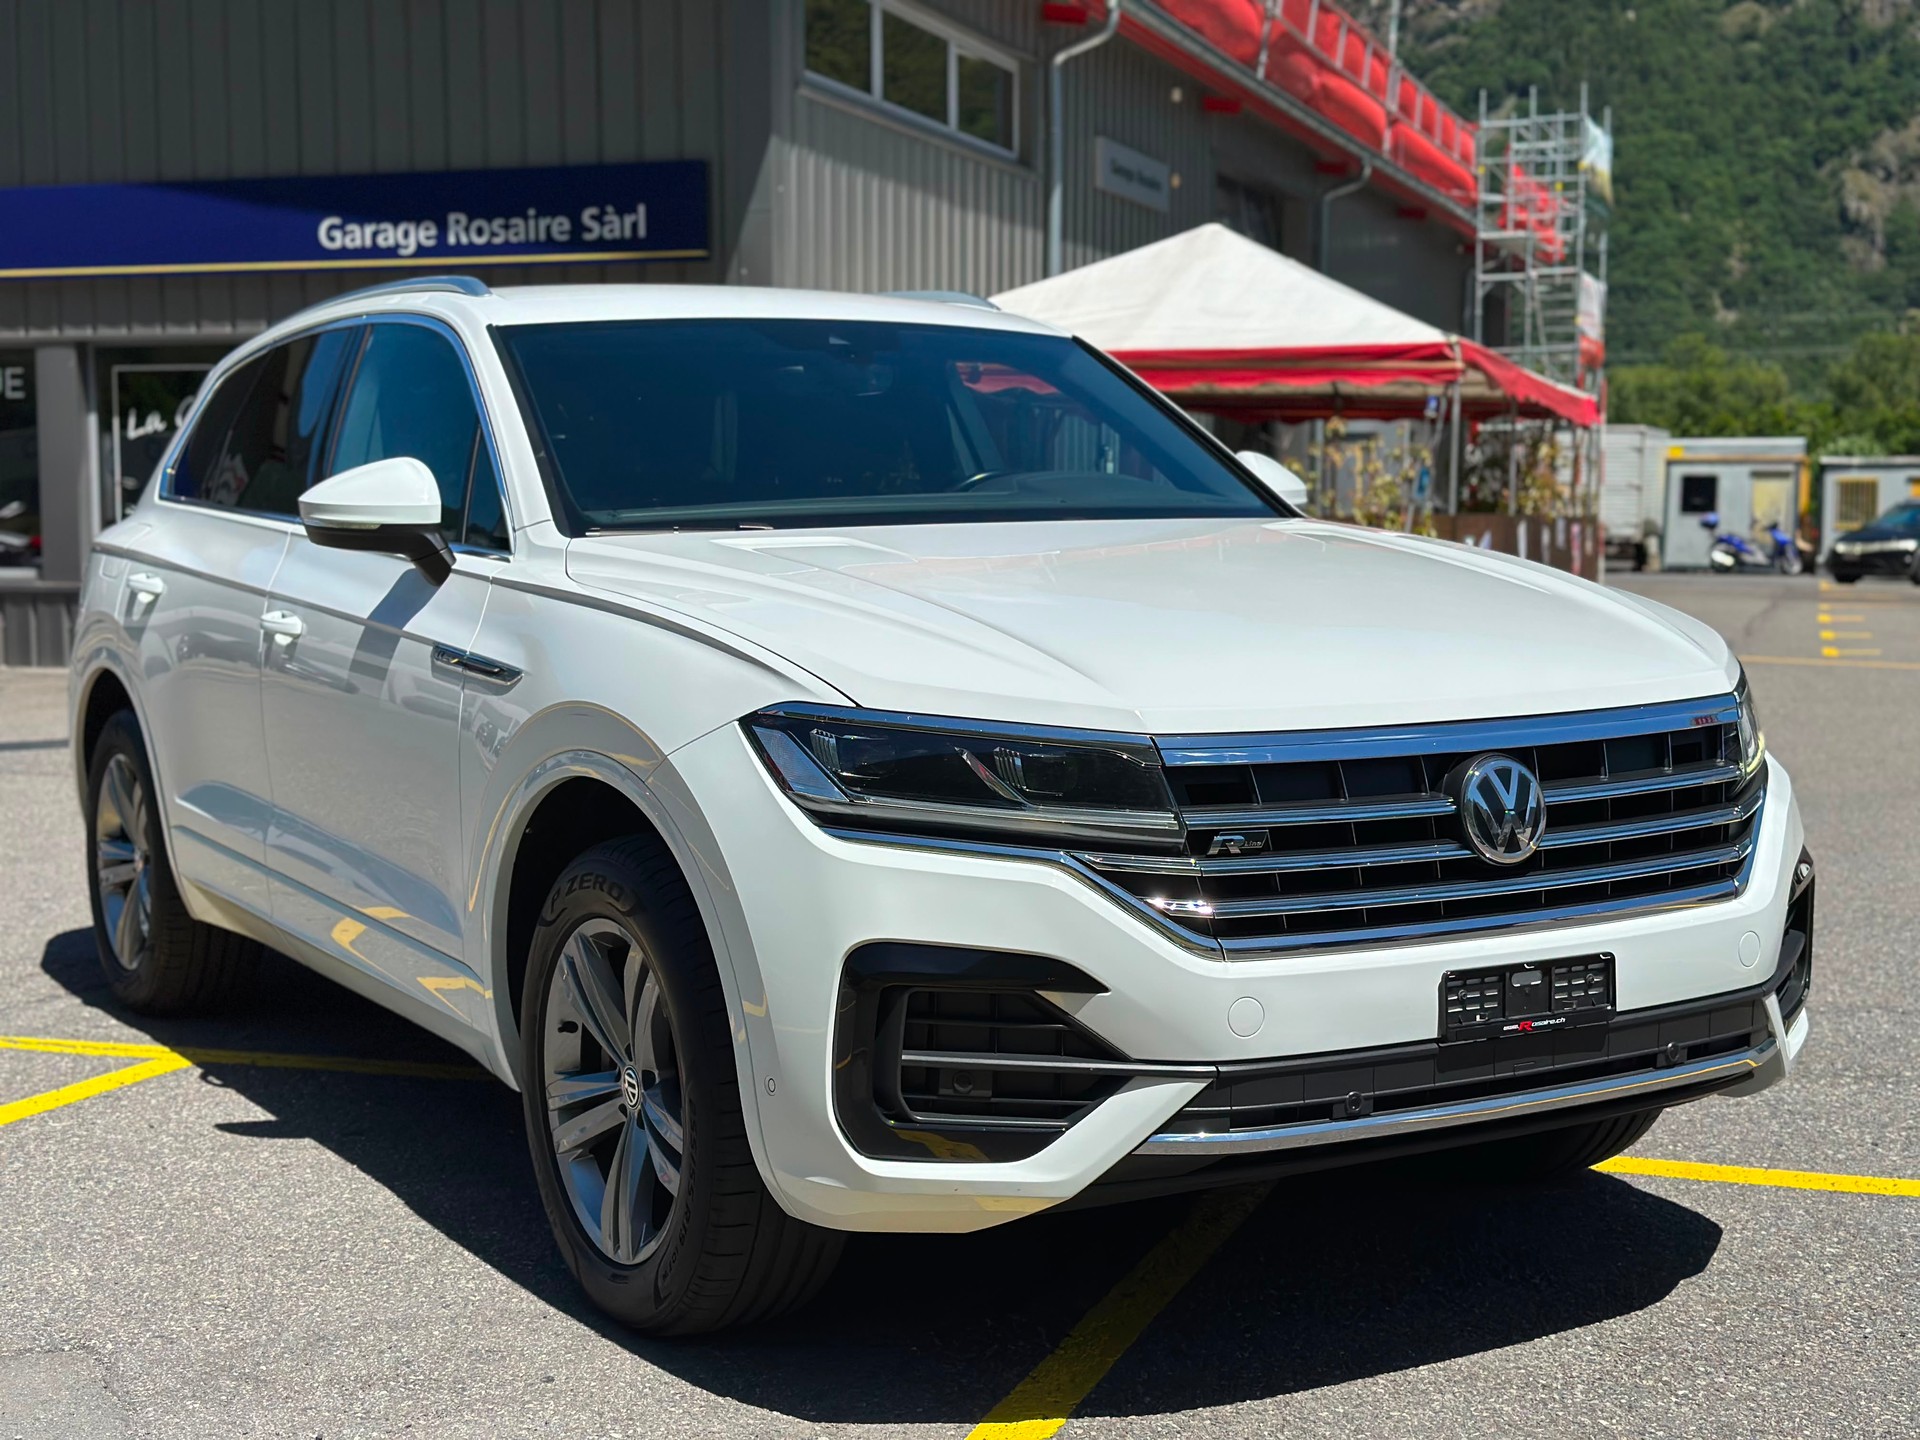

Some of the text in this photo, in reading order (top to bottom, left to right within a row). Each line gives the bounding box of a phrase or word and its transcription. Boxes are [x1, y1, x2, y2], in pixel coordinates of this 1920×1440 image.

[318, 203, 647, 256] Garage Rosaire Sàrl
[0, 366, 26, 399] E
[127, 407, 167, 440] La
[565, 872, 625, 902] ZERO
